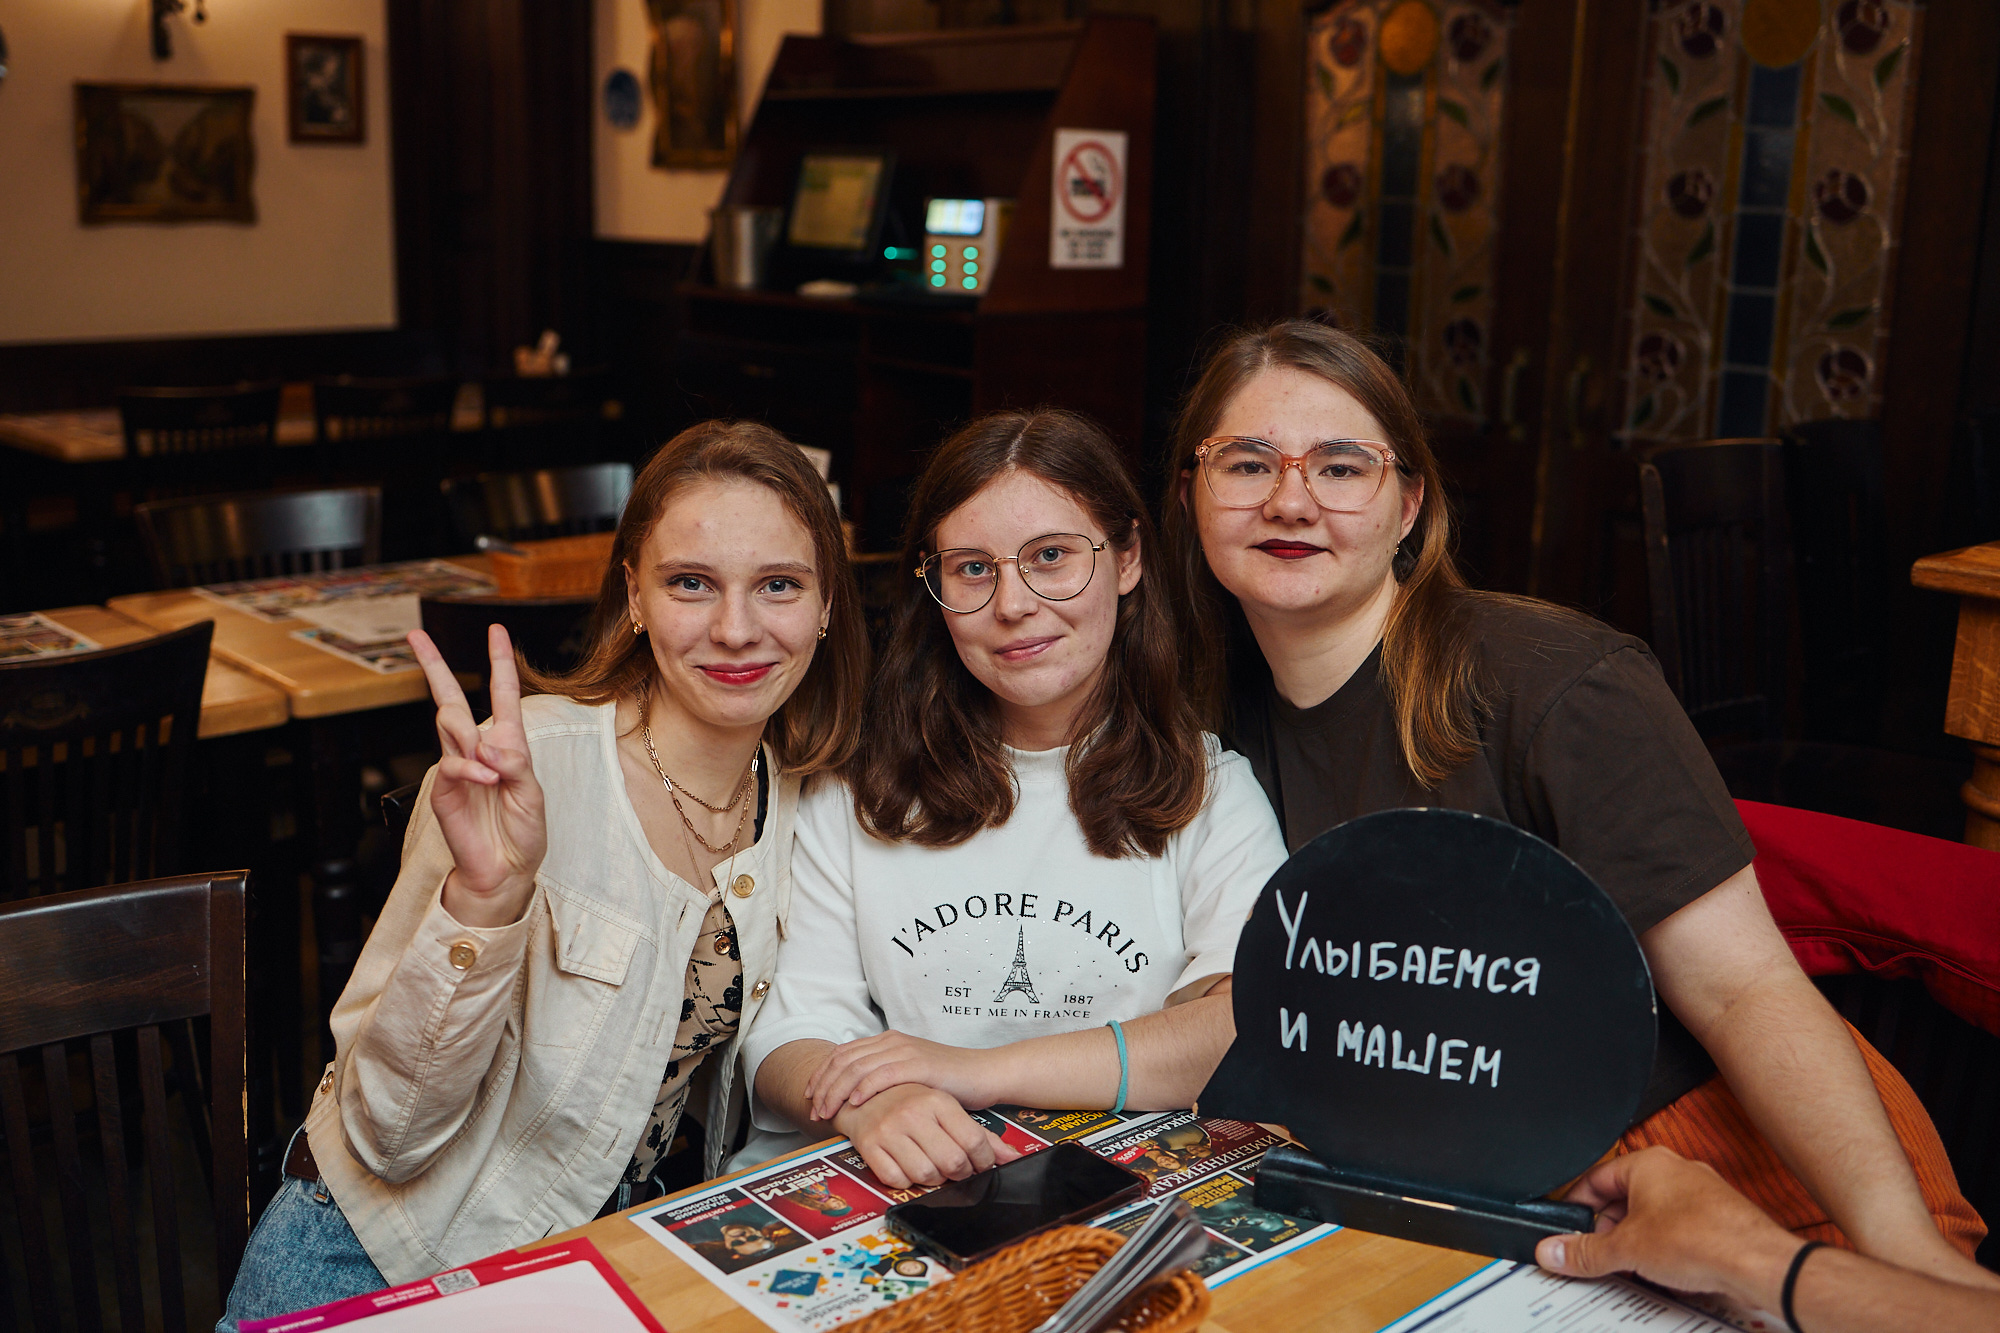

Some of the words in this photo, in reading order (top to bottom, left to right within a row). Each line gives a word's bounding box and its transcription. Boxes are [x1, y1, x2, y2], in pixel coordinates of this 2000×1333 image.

[891, 892, 1039, 958] J'ADORE
[1052, 899, 1149, 974] PARIS
[945, 986, 972, 998] EST
[1063, 993, 1094, 1006] 1887
[941, 1004, 982, 1016] MEET
[988, 1008, 1008, 1017] ME
[1014, 1008, 1028, 1018] IN
[1034, 1009, 1091, 1019] FRANCE
[1280, 1007, 1308, 1052] И
[1336, 1019, 1501, 1088] МАШЕМ
[1095, 1112, 1200, 1157] ИДКА=ВОЗРАСТ
[752, 1164, 828, 1194] ГОГИТИДЗЕ
[1149, 1134, 1280, 1195] ИМЕНИННИКАМ
[757, 1168, 839, 1201] МЕГИ
[892, 1189, 921, 1203] 14
[674, 1198, 732, 1221] ВЛАДИМИР
